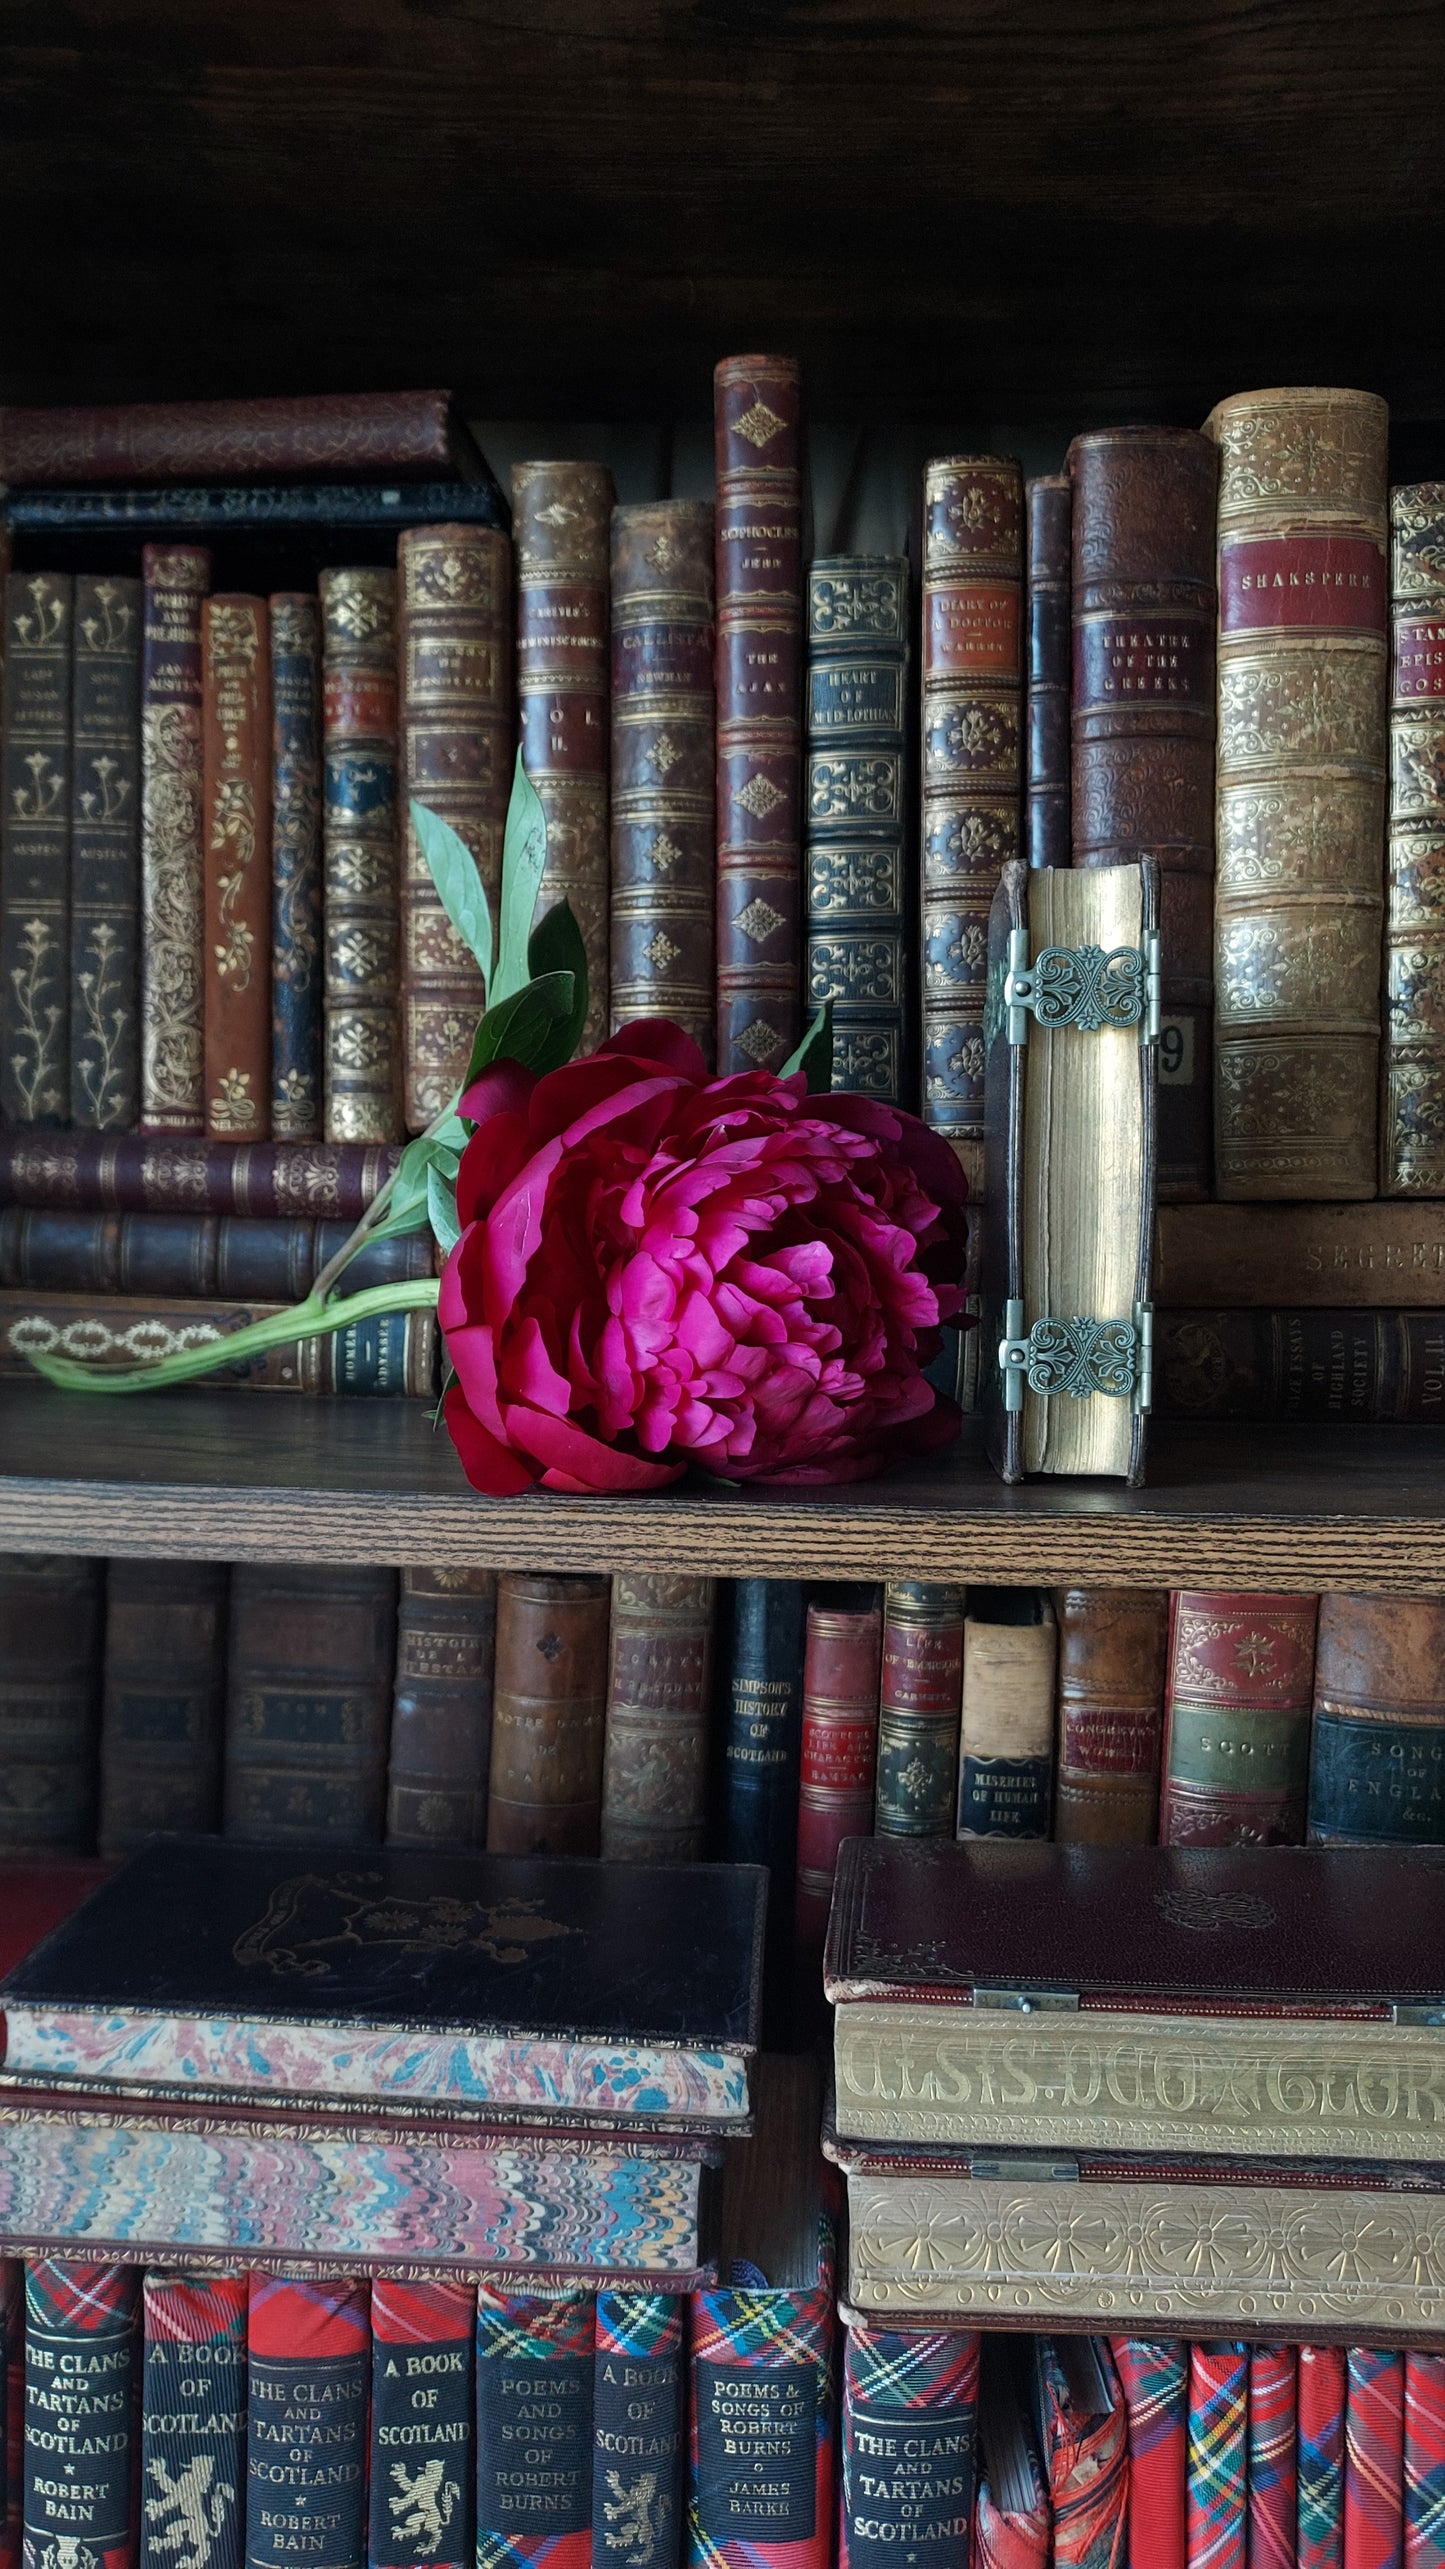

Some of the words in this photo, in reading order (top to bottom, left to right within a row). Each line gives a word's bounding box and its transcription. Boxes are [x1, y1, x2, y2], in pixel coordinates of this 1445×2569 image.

[721, 526, 799, 541] SOPHOCLES
[1241, 571, 1371, 590] SHAKSPERE
[940, 600, 985, 613] DIARY
[949, 617, 1013, 630] DOCTOR
[1102, 634, 1191, 649] THEATRE
[746, 653, 778, 665] THE
[1112, 654, 1135, 668] OF
[1147, 654, 1179, 668] THE
[1400, 651, 1443, 668] EPIS
[736, 680, 786, 694] AJAX
[829, 671, 877, 687] HEART
[1103, 677, 1191, 692] GREEKS
[840, 690, 864, 704] OF
[1328, 1329, 1345, 1410] HIGHLAND
[1350, 1336, 1368, 1407] SOCIETY
[885, 1654, 901, 1665] OF
[732, 1679, 792, 1696] SIMPSON'S
[734, 1699, 788, 1718] HISTORY
[749, 1723, 769, 1739] OF
[726, 1745, 788, 1764] SCOTLAND
[1201, 1737, 1291, 1757] SCOTT
[1371, 1742, 1445, 1761] SONG
[974, 1773, 1038, 1789] MISERIES
[1407, 1768, 1428, 1779] OF
[972, 1789, 988, 1802] OF
[994, 1791, 1039, 1804] HUMAN
[1348, 1780, 1443, 1800] ENGLA
[989, 1810, 1021, 1823] LIFE
[25, 2344, 55, 2371] THE
[59, 2349, 130, 2375] CLANS
[148, 2342, 168, 2364] A
[177, 2343, 246, 2366] BOOK
[383, 2358, 400, 2378] A
[406, 2351, 466, 2377] BOOK
[51, 2375, 90, 2391] AND
[603, 2363, 617, 2385] A
[623, 2362, 680, 2388] BOOK
[180, 2378, 211, 2398] OF
[250, 2380, 286, 2402] THE
[292, 2379, 363, 2403] CLANS
[500, 2379, 581, 2397] POEMS
[713, 2380, 780, 2400] POEMS
[786, 2383, 800, 2400] &
[26, 2383, 124, 2415] TARTANS
[411, 2388, 439, 2409] OF
[284, 2407, 321, 2421] AND
[518, 2402, 562, 2420] AND
[628, 2402, 657, 2421] OF
[711, 2399, 770, 2418] SONGS
[779, 2401, 805, 2417] OF
[57, 2416, 81, 2433] OF
[254, 2420, 356, 2445] TARTANS
[378, 2421, 471, 2446] SCOTLAND
[501, 2424, 578, 2441] SONGS
[719, 2418, 799, 2436] ROBERT
[596, 2428, 682, 2456] SCOTLAND
[724, 2438, 792, 2456] BURNS
[853, 2430, 897, 2457] THE
[904, 2432, 970, 2458] CLANS
[289, 2449, 312, 2463] OF
[524, 2448, 553, 2465] OF
[249, 2457, 361, 2487] SCOTLAND
[892, 2461, 933, 2475] AND
[33, 2475, 109, 2501] ROBERT
[495, 2471, 580, 2487] ROBERT
[858, 2472, 964, 2500] TARTANS
[728, 2481, 791, 2497] JAMES
[45, 2499, 94, 2521] BAIN
[499, 2494, 573, 2511] BURNS
[728, 2499, 790, 2517] BARKE
[900, 2503, 924, 2518] OF
[260, 2510, 341, 2531] ROBERT
[853, 2516, 968, 2542] SCOTLAND
[273, 2533, 326, 2552] BAIN
